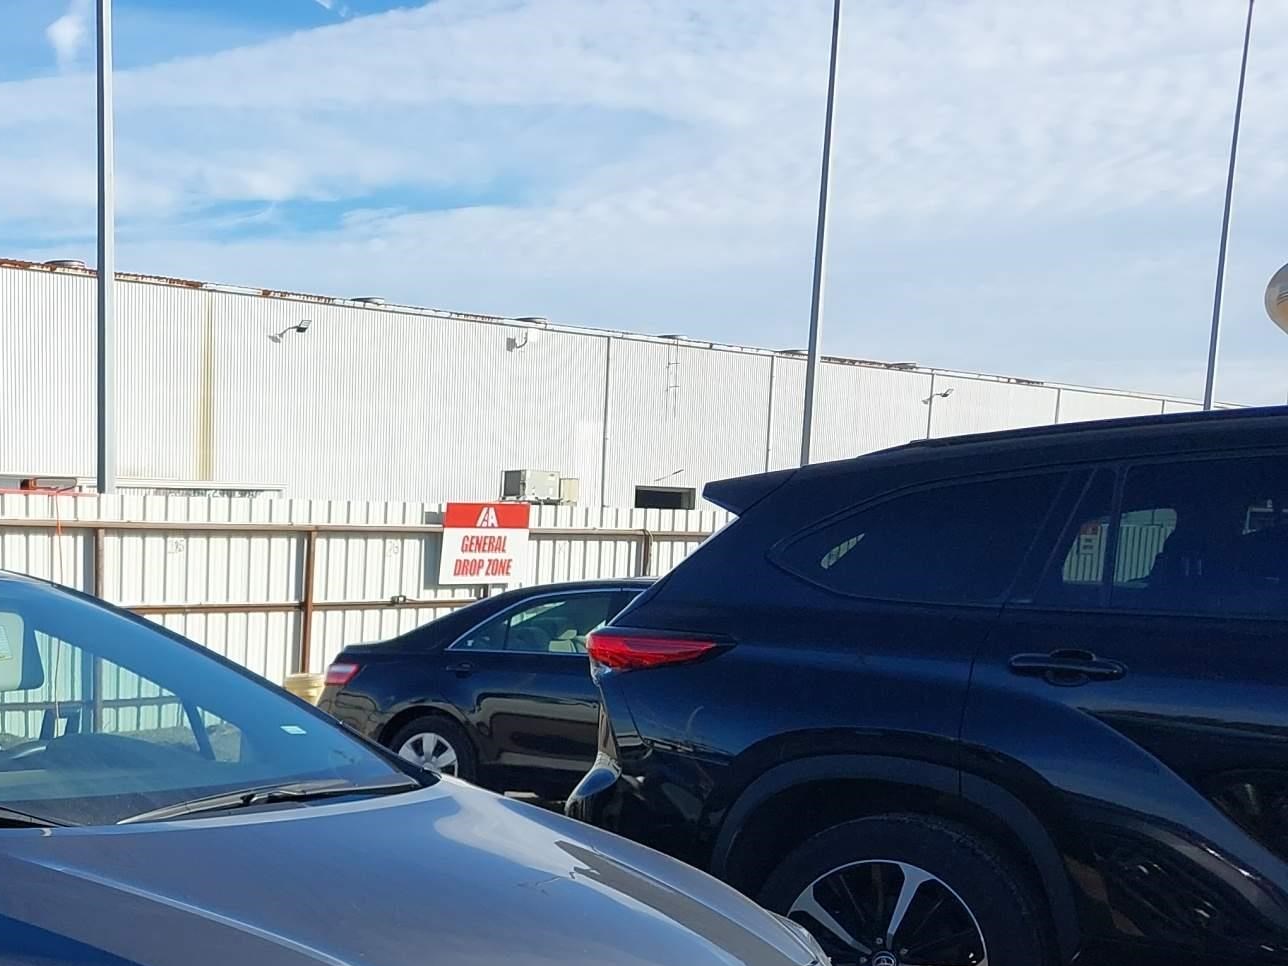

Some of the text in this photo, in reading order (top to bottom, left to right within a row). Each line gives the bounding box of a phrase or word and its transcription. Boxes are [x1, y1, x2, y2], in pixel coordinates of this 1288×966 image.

[461, 535, 507, 553] GENERAL
[453, 559, 512, 577] DROP ZONE
